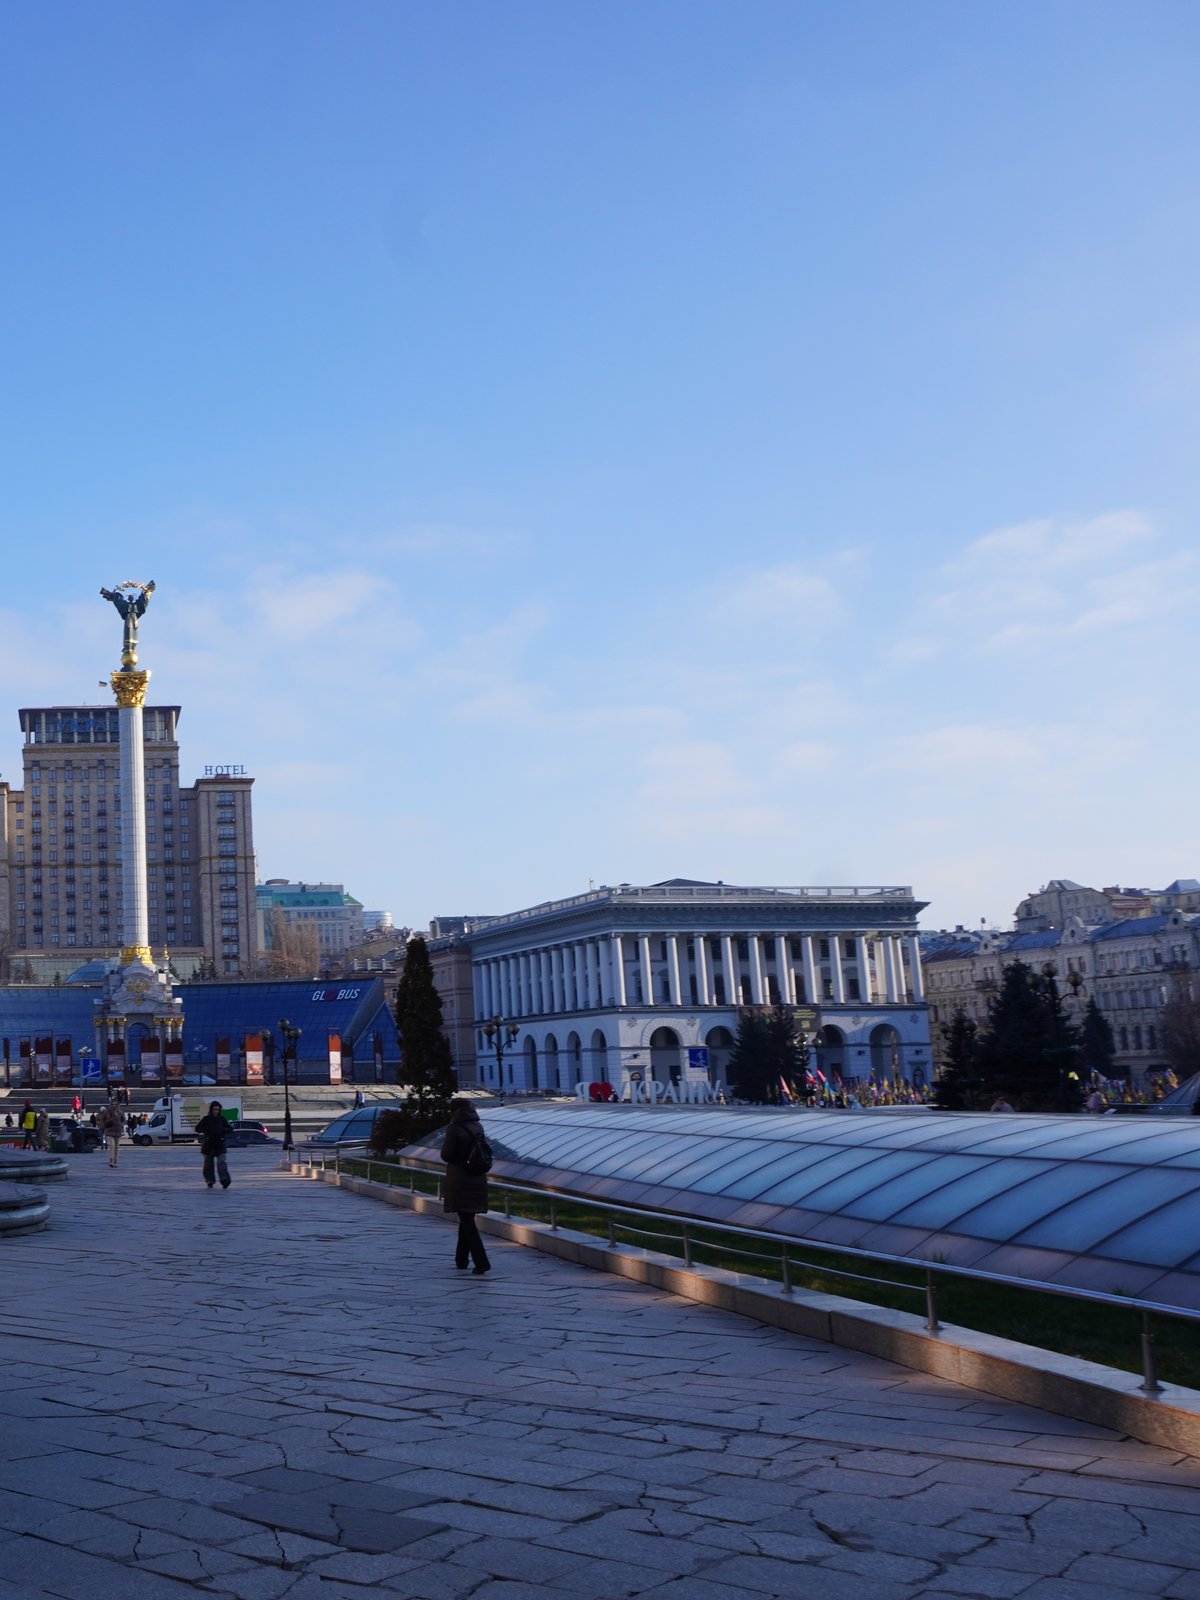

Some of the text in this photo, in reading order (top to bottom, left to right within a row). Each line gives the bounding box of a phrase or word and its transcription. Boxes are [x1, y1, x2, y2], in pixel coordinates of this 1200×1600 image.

[204, 765, 248, 775] HOTEL
[575, 1079, 721, 1105] Я УКРАЇНУ
